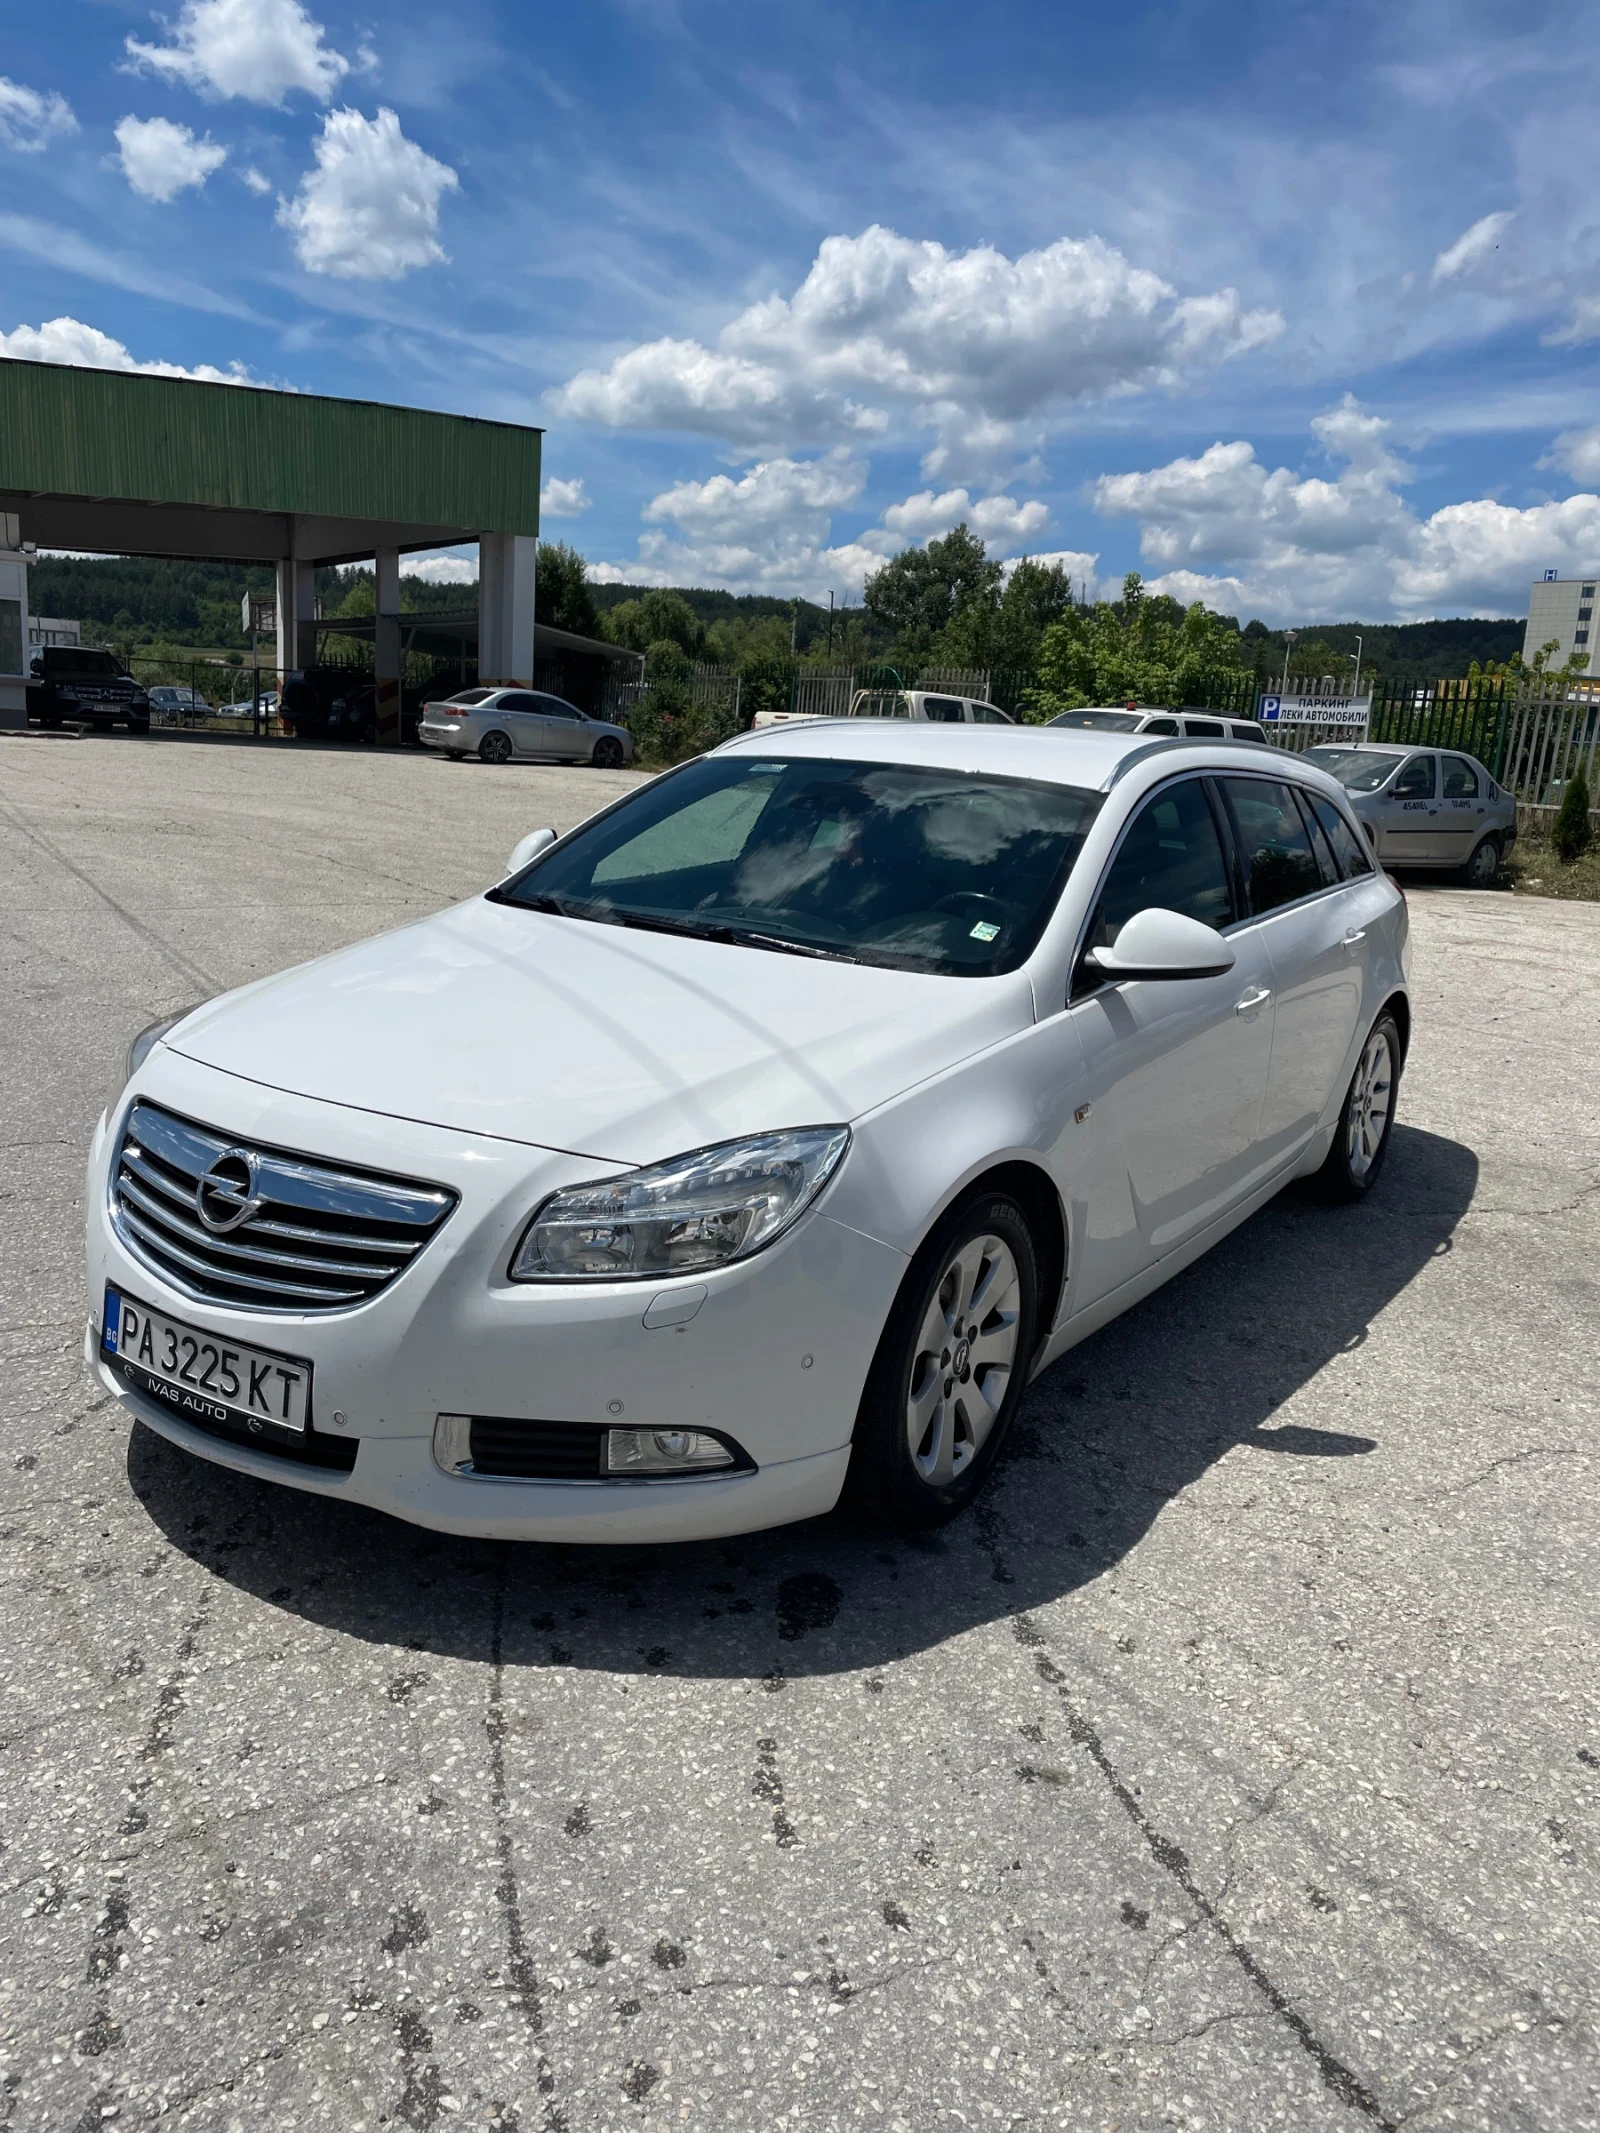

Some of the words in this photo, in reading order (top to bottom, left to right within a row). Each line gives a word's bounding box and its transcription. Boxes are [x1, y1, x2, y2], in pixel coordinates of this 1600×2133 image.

[1545, 570, 1556, 581] H
[1263, 697, 1278, 719] P
[1298, 698, 1352, 709] ПАРКИНГ
[1280, 709, 1303, 720] ЛЕКИ
[1305, 711, 1368, 722] АВТОМОБИЛИ
[106, 1327, 118, 1344] BG
[148, 1378, 179, 1402] IVAS
[183, 1395, 227, 1421] AUTO
